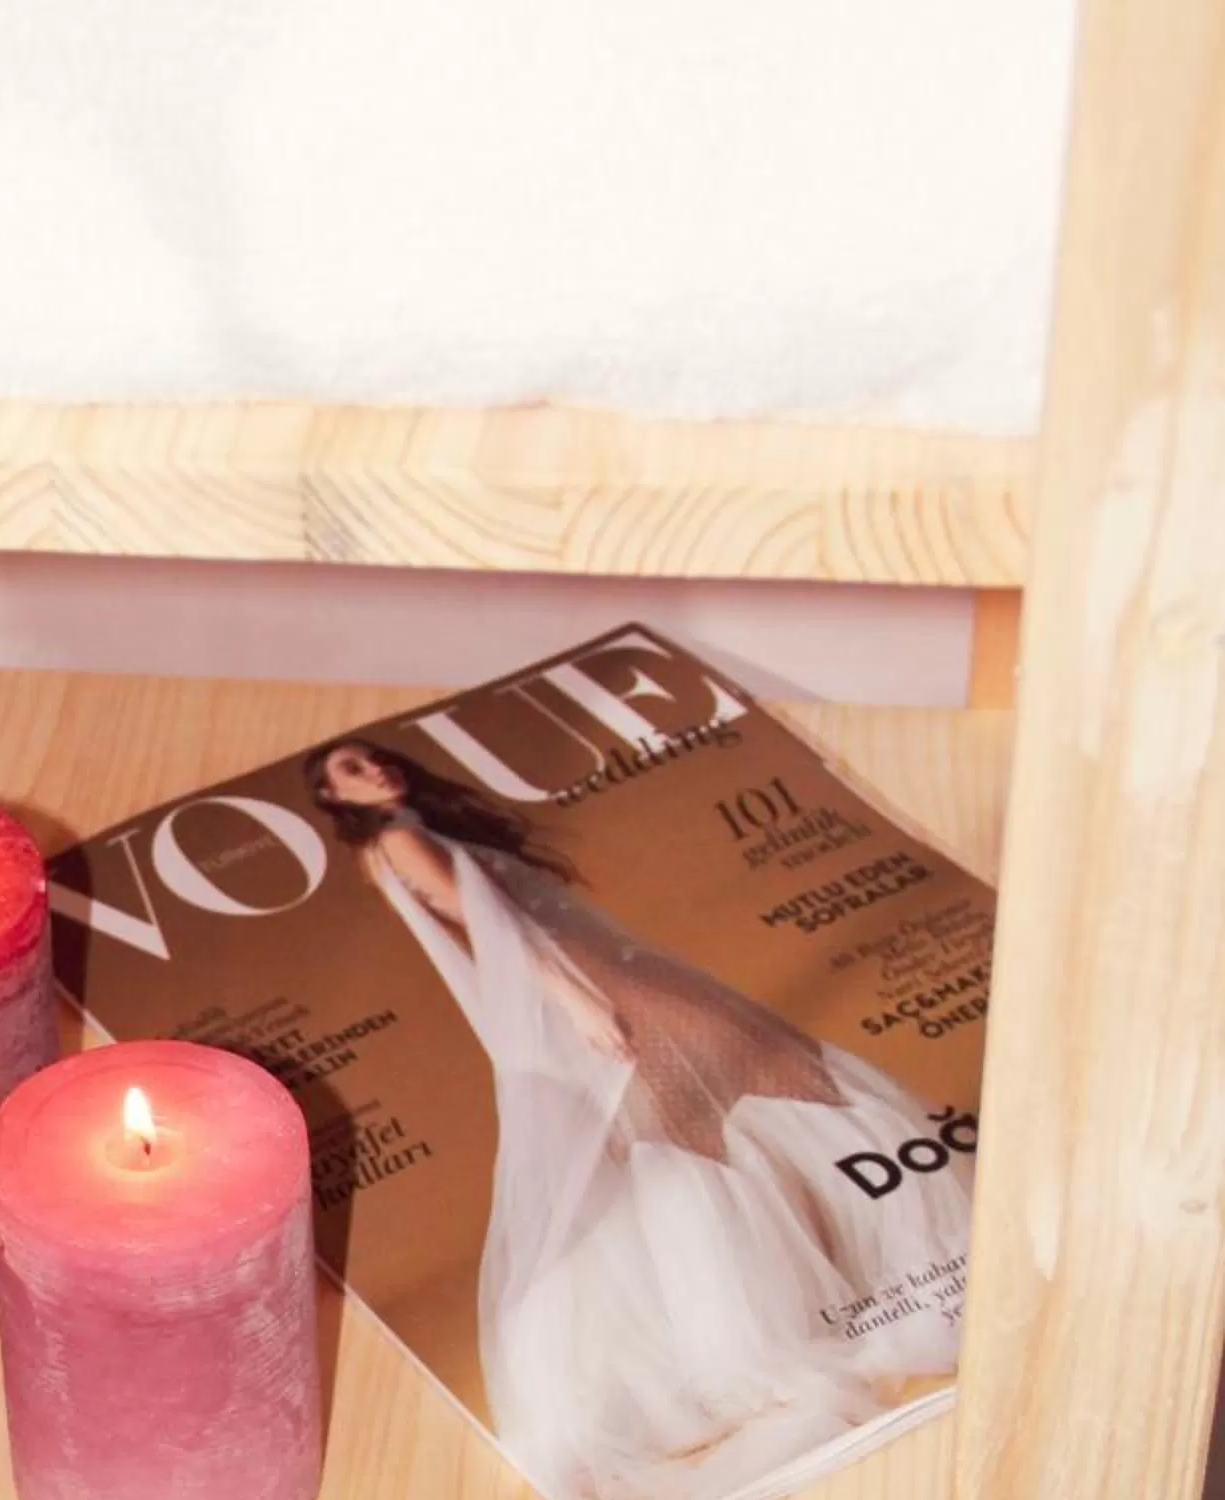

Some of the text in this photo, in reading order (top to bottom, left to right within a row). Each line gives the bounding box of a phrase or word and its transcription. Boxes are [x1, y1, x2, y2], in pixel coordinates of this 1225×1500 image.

[46, 630, 749, 962] VOUE
[552, 722, 742, 808] wedding
[714, 776, 798, 840] 101
[759, 851, 913, 928] MUTLU EDEN
